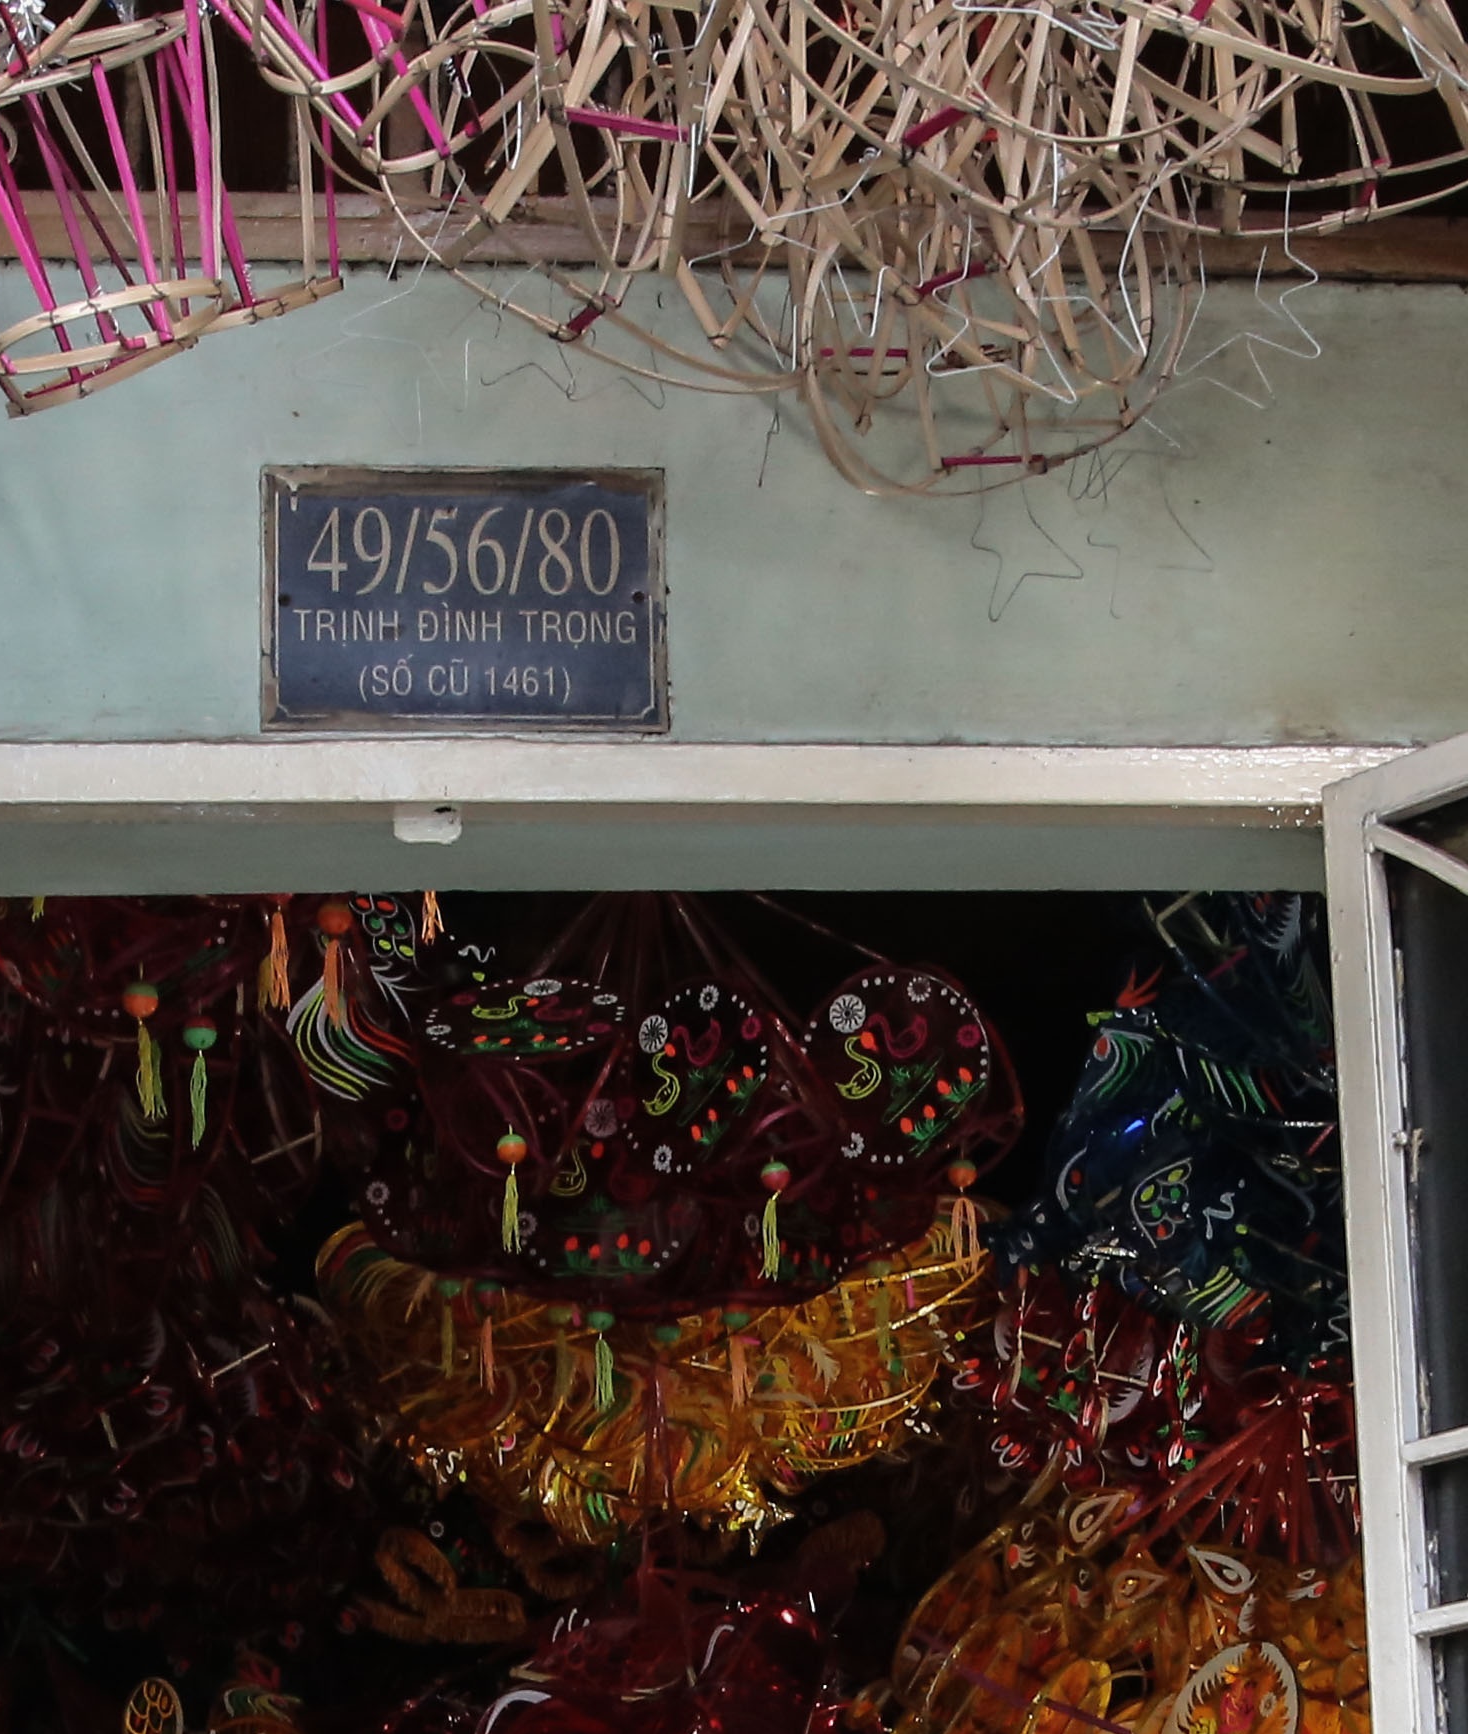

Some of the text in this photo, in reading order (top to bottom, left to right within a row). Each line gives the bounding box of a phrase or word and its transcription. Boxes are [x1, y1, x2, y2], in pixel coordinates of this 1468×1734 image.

[307, 506, 621, 596] 49/56/80
[293, 602, 637, 651] TRỊNH ĐÌNH TRỌNG
[358, 653, 572, 703] (SỐ CŨ 1461)
